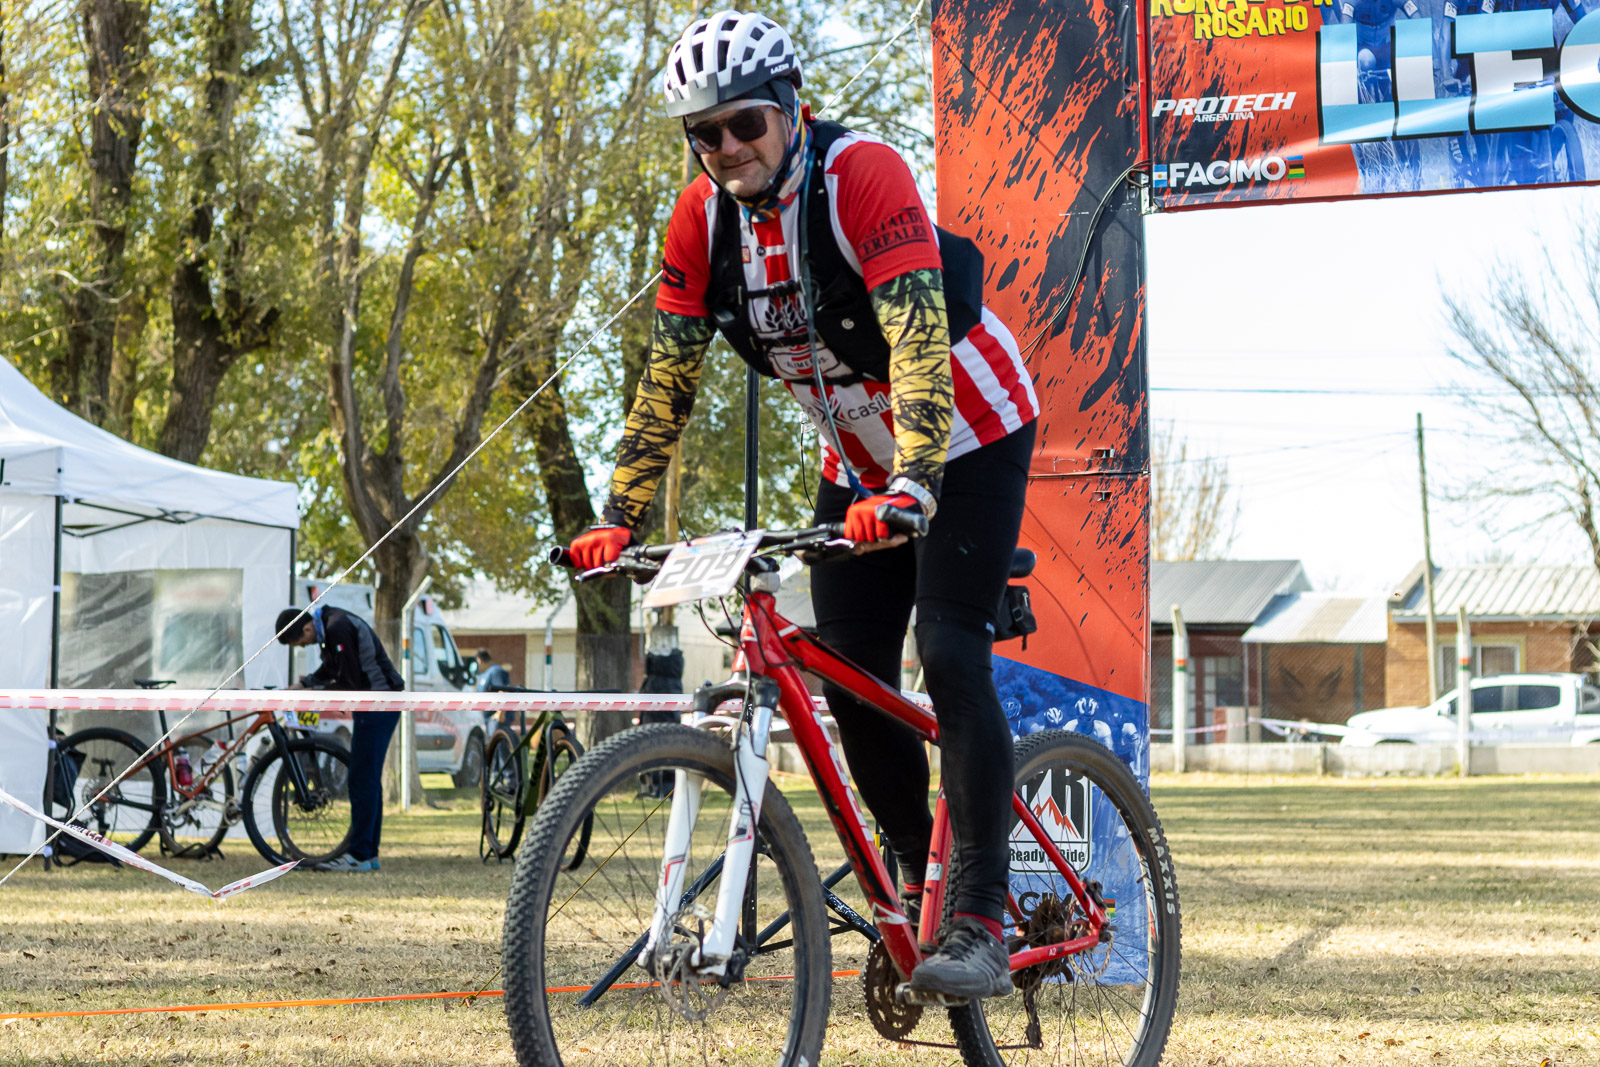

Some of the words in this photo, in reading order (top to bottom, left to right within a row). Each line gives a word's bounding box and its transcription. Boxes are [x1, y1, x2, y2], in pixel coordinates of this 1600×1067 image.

[1194, 6, 1308, 40] ROSARIO
[1152, 92, 1297, 117] PROTECH
[1193, 111, 1254, 123] ARGENTINA
[1169, 156, 1287, 188] FACIMO
[847, 392, 891, 421] casil
[656, 550, 746, 590] 209
[1009, 849, 1045, 863] Ready
[1147, 827, 1176, 915] MAXXIS
